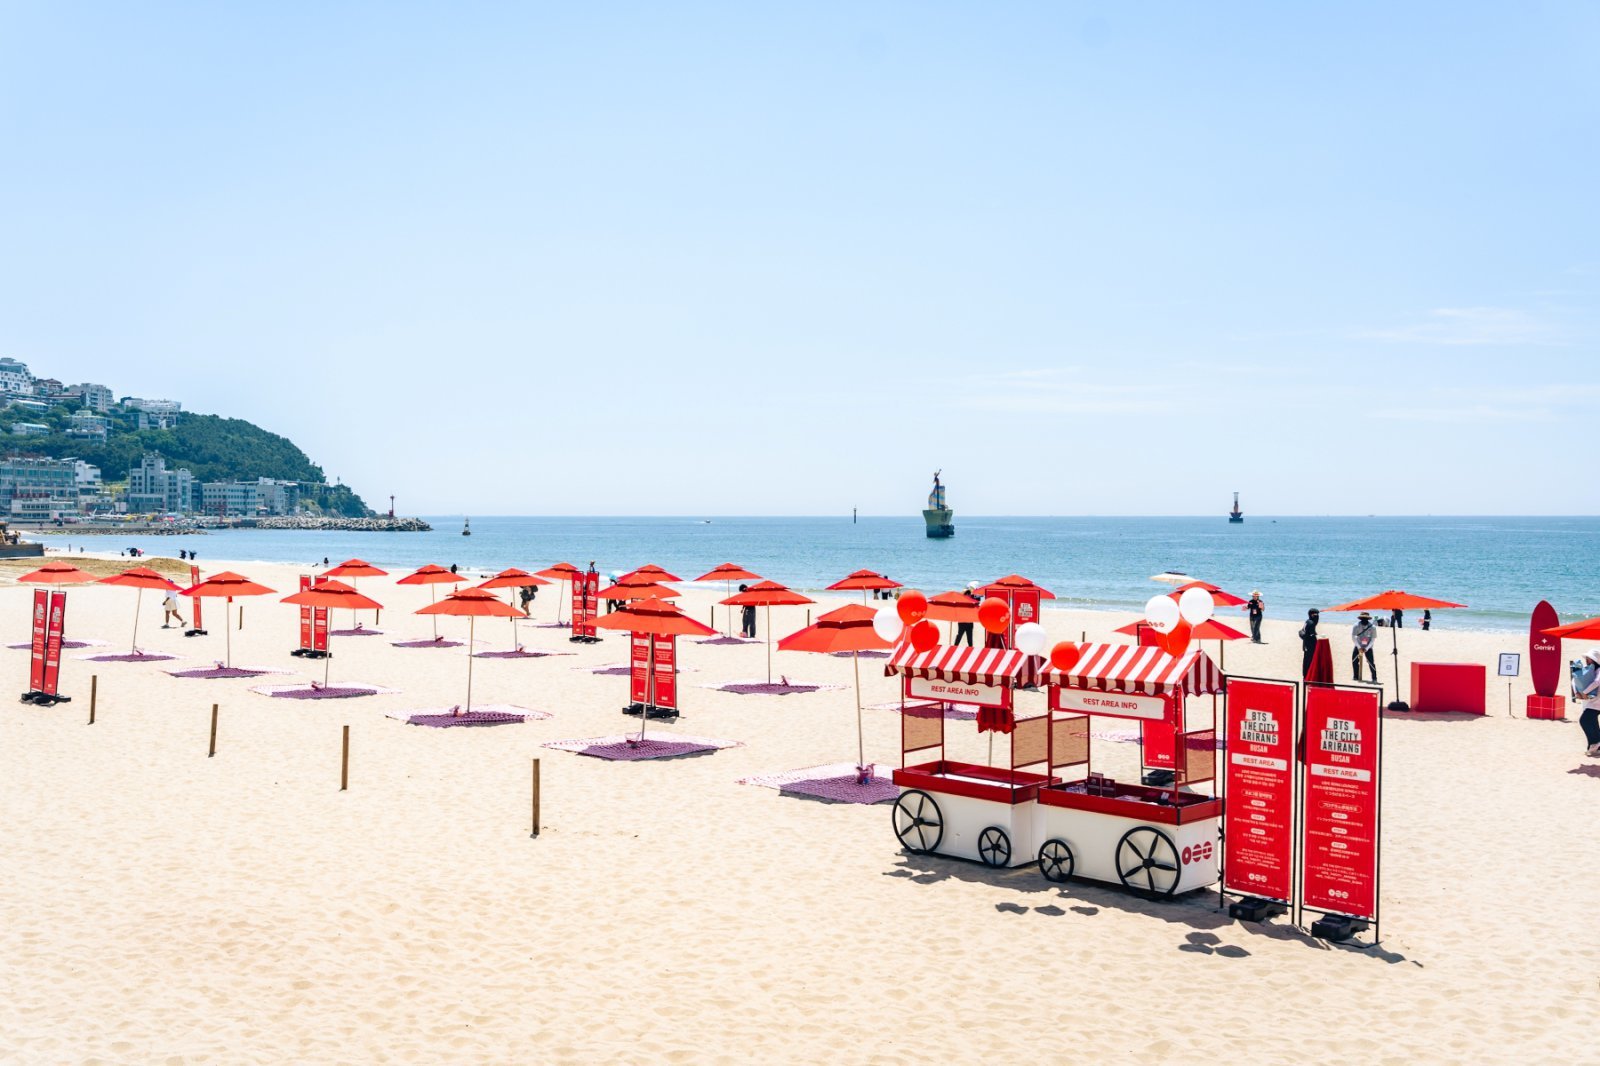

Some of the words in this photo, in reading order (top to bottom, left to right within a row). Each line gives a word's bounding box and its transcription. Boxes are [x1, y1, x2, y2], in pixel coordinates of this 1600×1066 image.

[1533, 643, 1556, 651] Gemini
[931, 685, 945, 693] REST
[947, 687, 963, 695] AREA
[964, 689, 979, 697] INFO
[1083, 697, 1100, 706] REST
[1101, 699, 1120, 708] AREA
[1121, 701, 1138, 710] INFO
[1251, 711, 1267, 722] BTS
[1244, 721, 1257, 731] THE
[1259, 722, 1276, 733] CITY
[1333, 720, 1349, 730] BTS
[1242, 731, 1277, 744] ARIRANG
[1325, 730, 1339, 741] THE
[1340, 731, 1358, 742] CITY
[1250, 743, 1268, 753] BUSAN
[1322, 740, 1359, 754] ARIRANG
[1243, 757, 1258, 765] REST
[1259, 759, 1275, 767] AREA
[1331, 753, 1350, 763] BUSAN
[1323, 767, 1339, 775] REST
[1340, 769, 1358, 777] AREA
